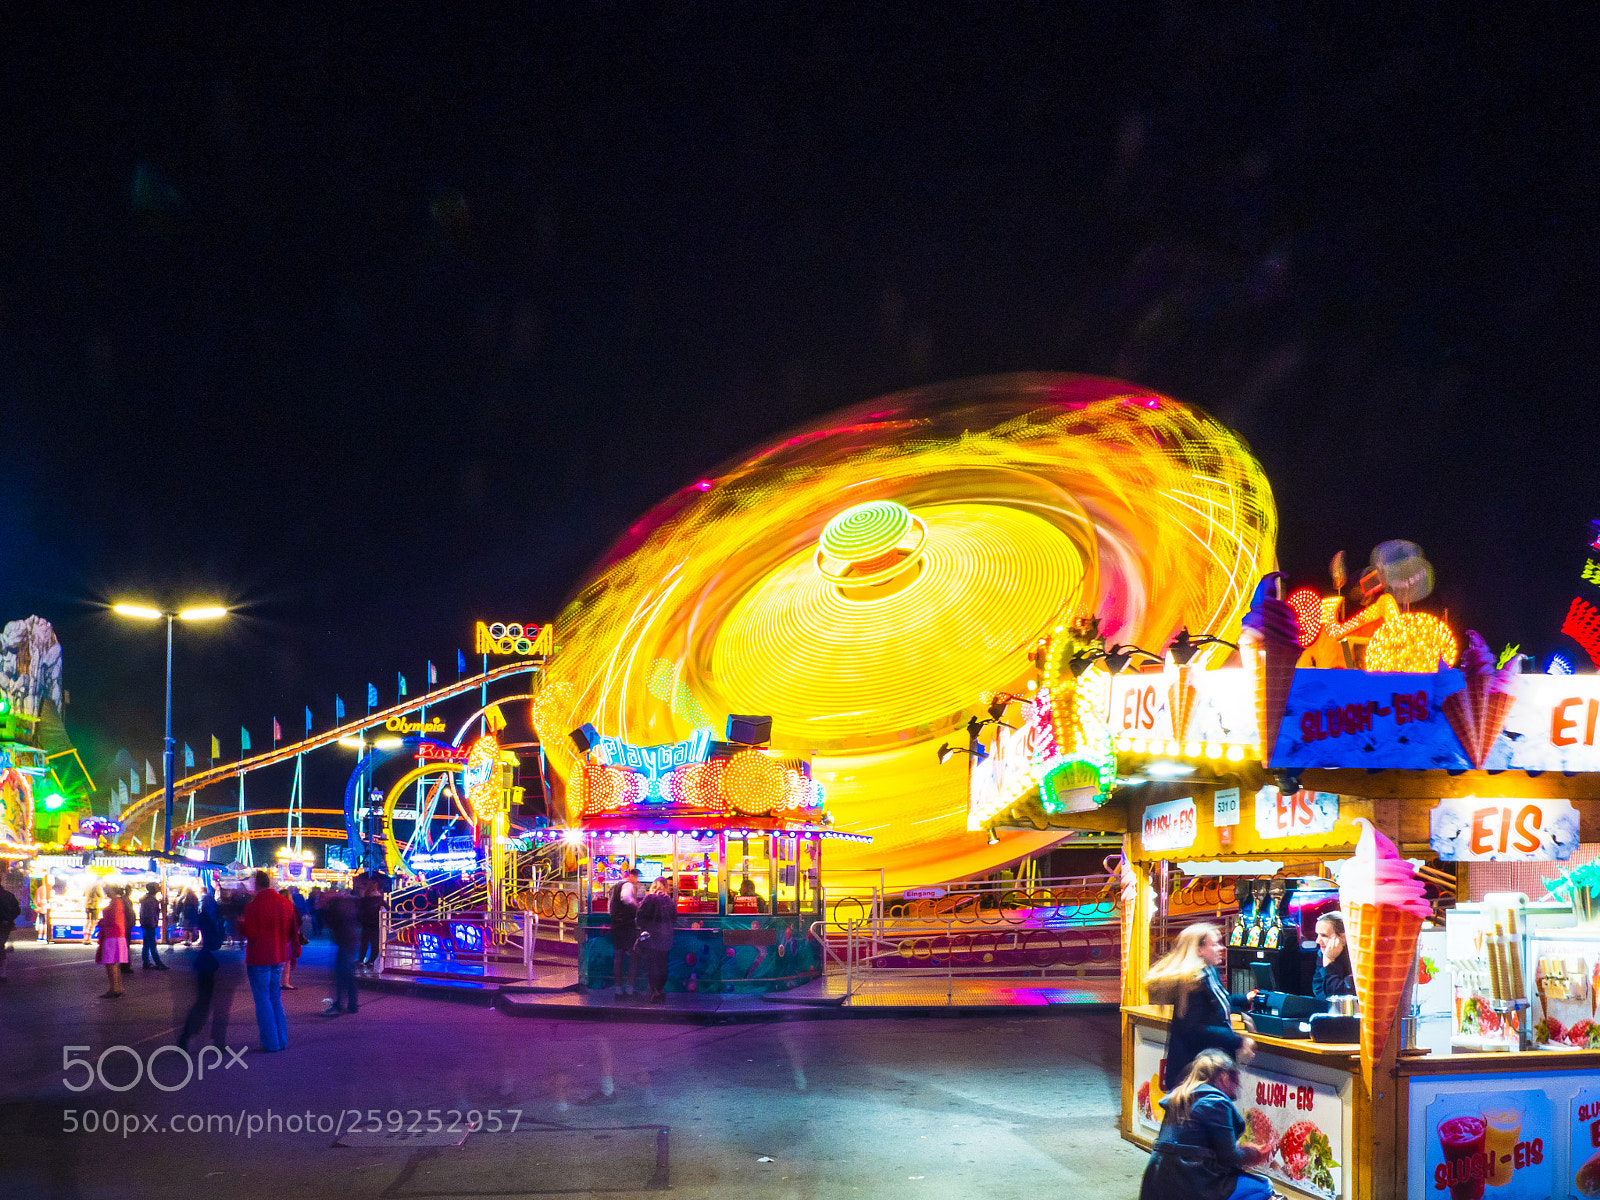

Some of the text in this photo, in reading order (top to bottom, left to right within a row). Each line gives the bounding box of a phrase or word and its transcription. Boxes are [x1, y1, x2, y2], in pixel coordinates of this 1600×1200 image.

[385, 716, 446, 734] Olympia
[1123, 685, 1156, 730] EIS
[600, 729, 711, 781] Playball
[1276, 789, 1316, 831] EIS
[1469, 804, 1543, 856] EIS
[1578, 1101, 1600, 1122] SLU
